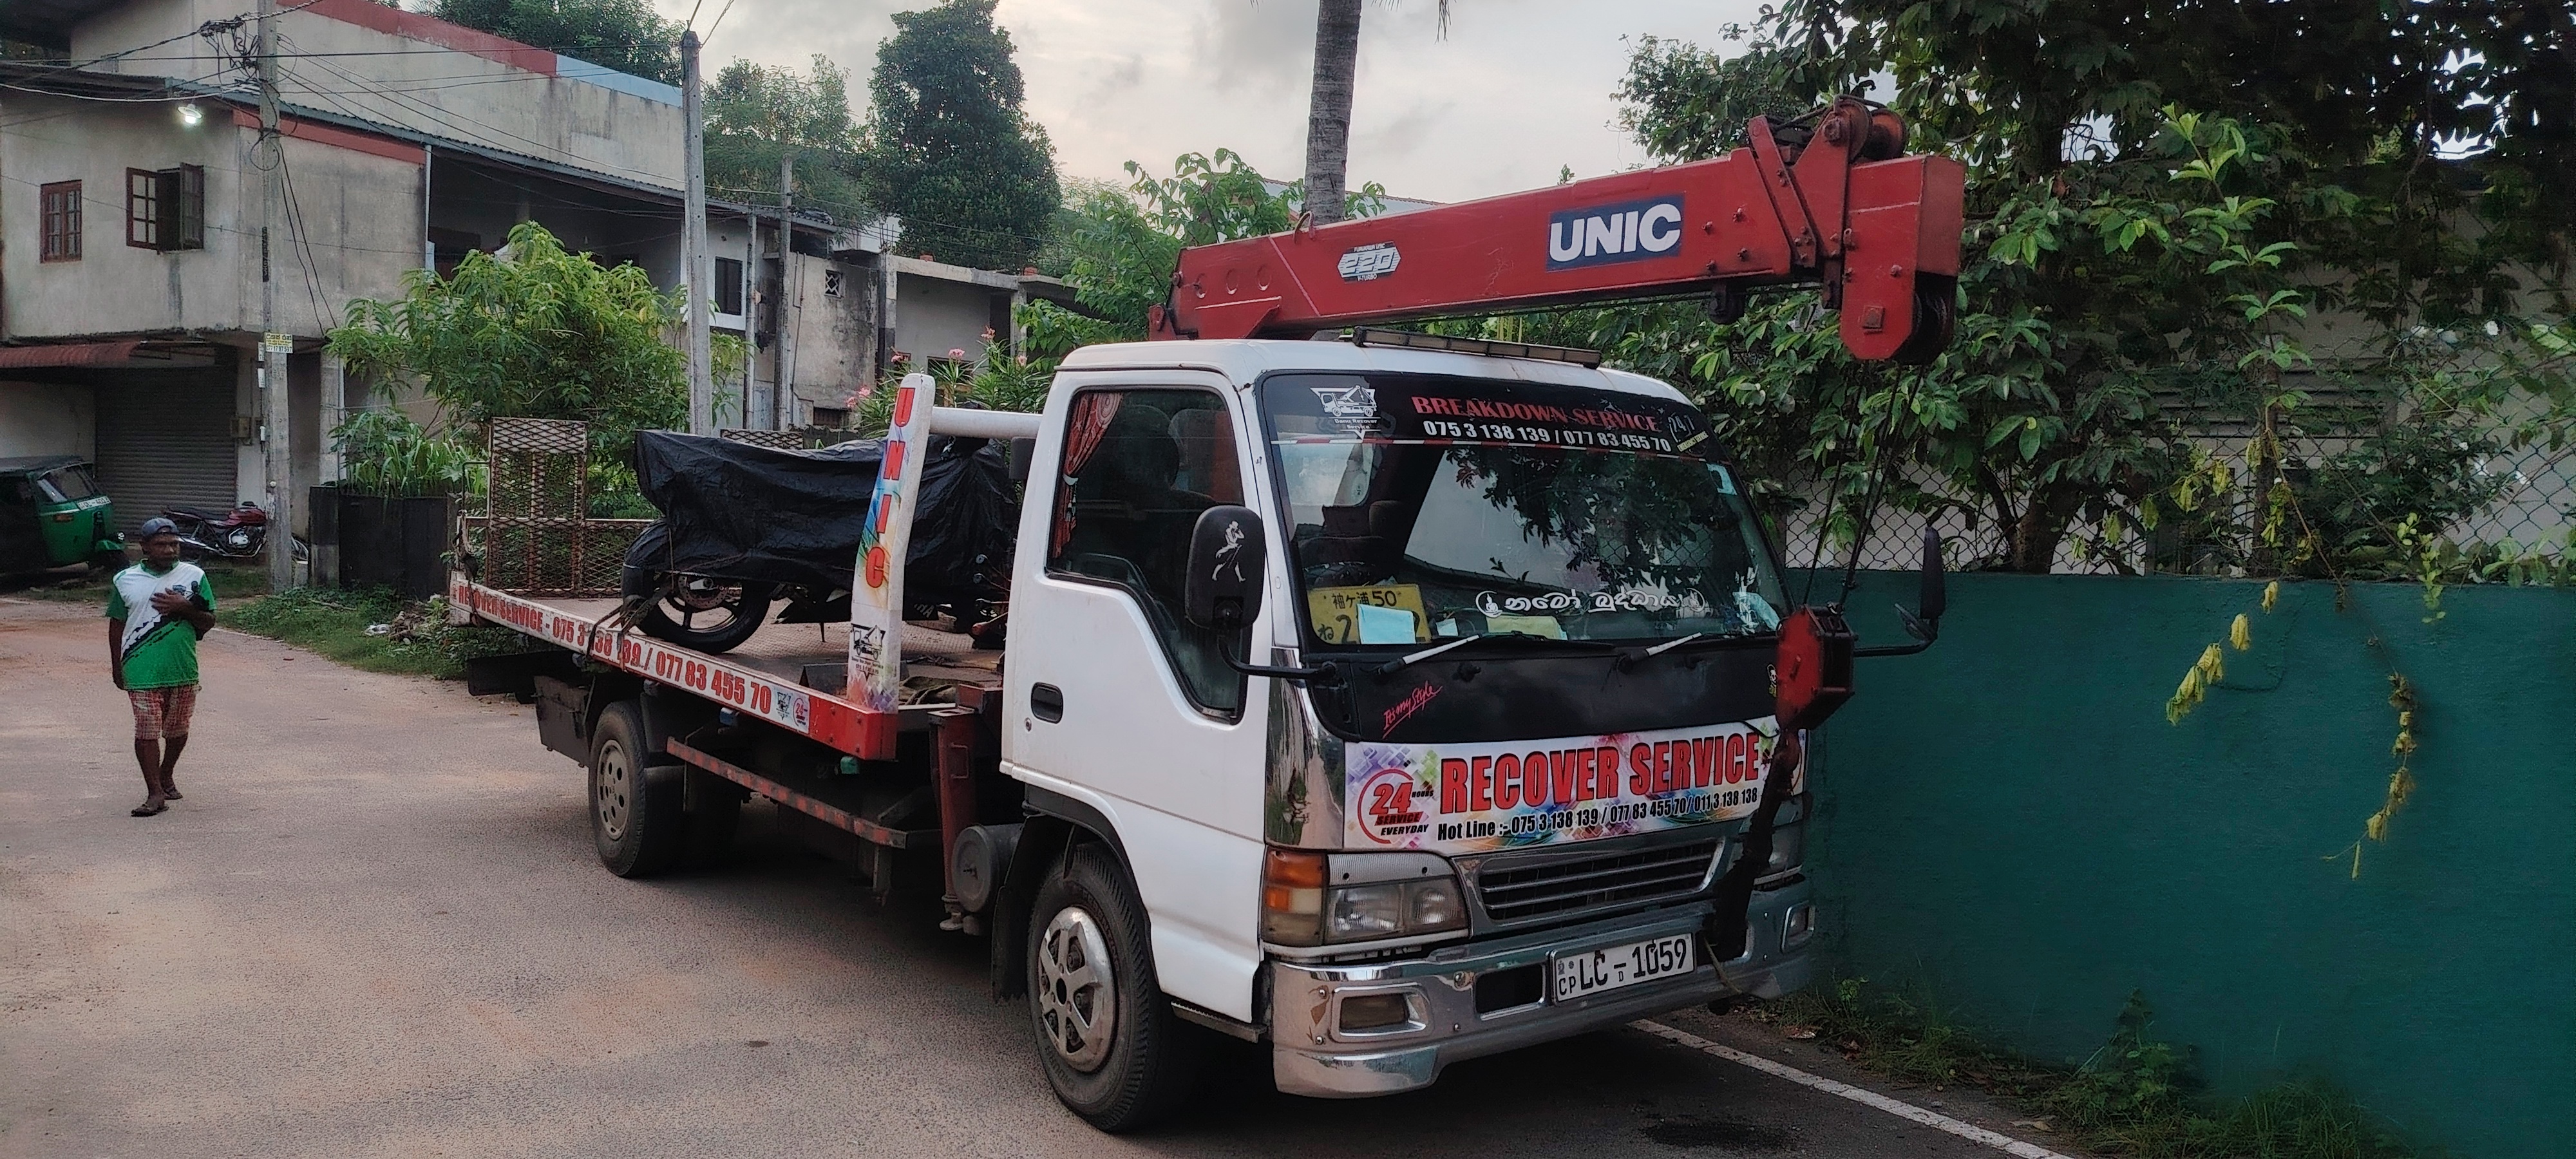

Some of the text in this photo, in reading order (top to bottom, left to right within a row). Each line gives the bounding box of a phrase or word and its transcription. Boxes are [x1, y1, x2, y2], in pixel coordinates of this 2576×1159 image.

[1549, 203, 1681, 262] UNIC
[1342, 251, 1395, 275] 220
[1411, 397, 1663, 433] BREAKDOWN SERVICE
[1423, 420, 1462, 437] 075
[1463, 423, 1477, 438] 3
[1479, 424, 1515, 440] 138
[1517, 426, 1551, 442] 139
[1562, 430, 1594, 446] 077
[1597, 431, 1619, 447] 83
[1621, 434, 1651, 449] 455
[1651, 437, 1672, 452] 70
[866, 387, 916, 588] UNIC
[1372, 590, 1397, 607] 50
[1504, 588, 1581, 611] නමෝ
[459, 585, 498, 616] REOVER
[500, 599, 543, 632] SERVICE
[553, 616, 574, 643] 075
[592, 630, 612, 657] 38
[618, 639, 641, 666] 39
[656, 651, 683, 682] 077
[685, 661, 707, 690] 83
[711, 670, 745, 704] 455
[750, 682, 772, 714] 70
[1440, 732, 1760, 814] RECOVER SERVICE
[1369, 782, 1413, 815] 24
[1437, 823, 1463, 841] Hot
[1466, 820, 1496, 838] Line
[1511, 815, 1535, 834] 075
[1539, 814, 1547, 831] 3
[1551, 811, 1573, 829] 138
[1577, 808, 1598, 826] 139
[1610, 805, 1630, 823] 077
[1632, 802, 1647, 819] 83
[1649, 798, 1671, 816] 455
[1713, 793, 1719, 809] 3
[1722, 791, 1739, 807] 138
[1741, 787, 1757, 804] 138
[1376, 813, 1420, 825] SERVICE
[1380, 824, 1429, 836] EVERYDAY
